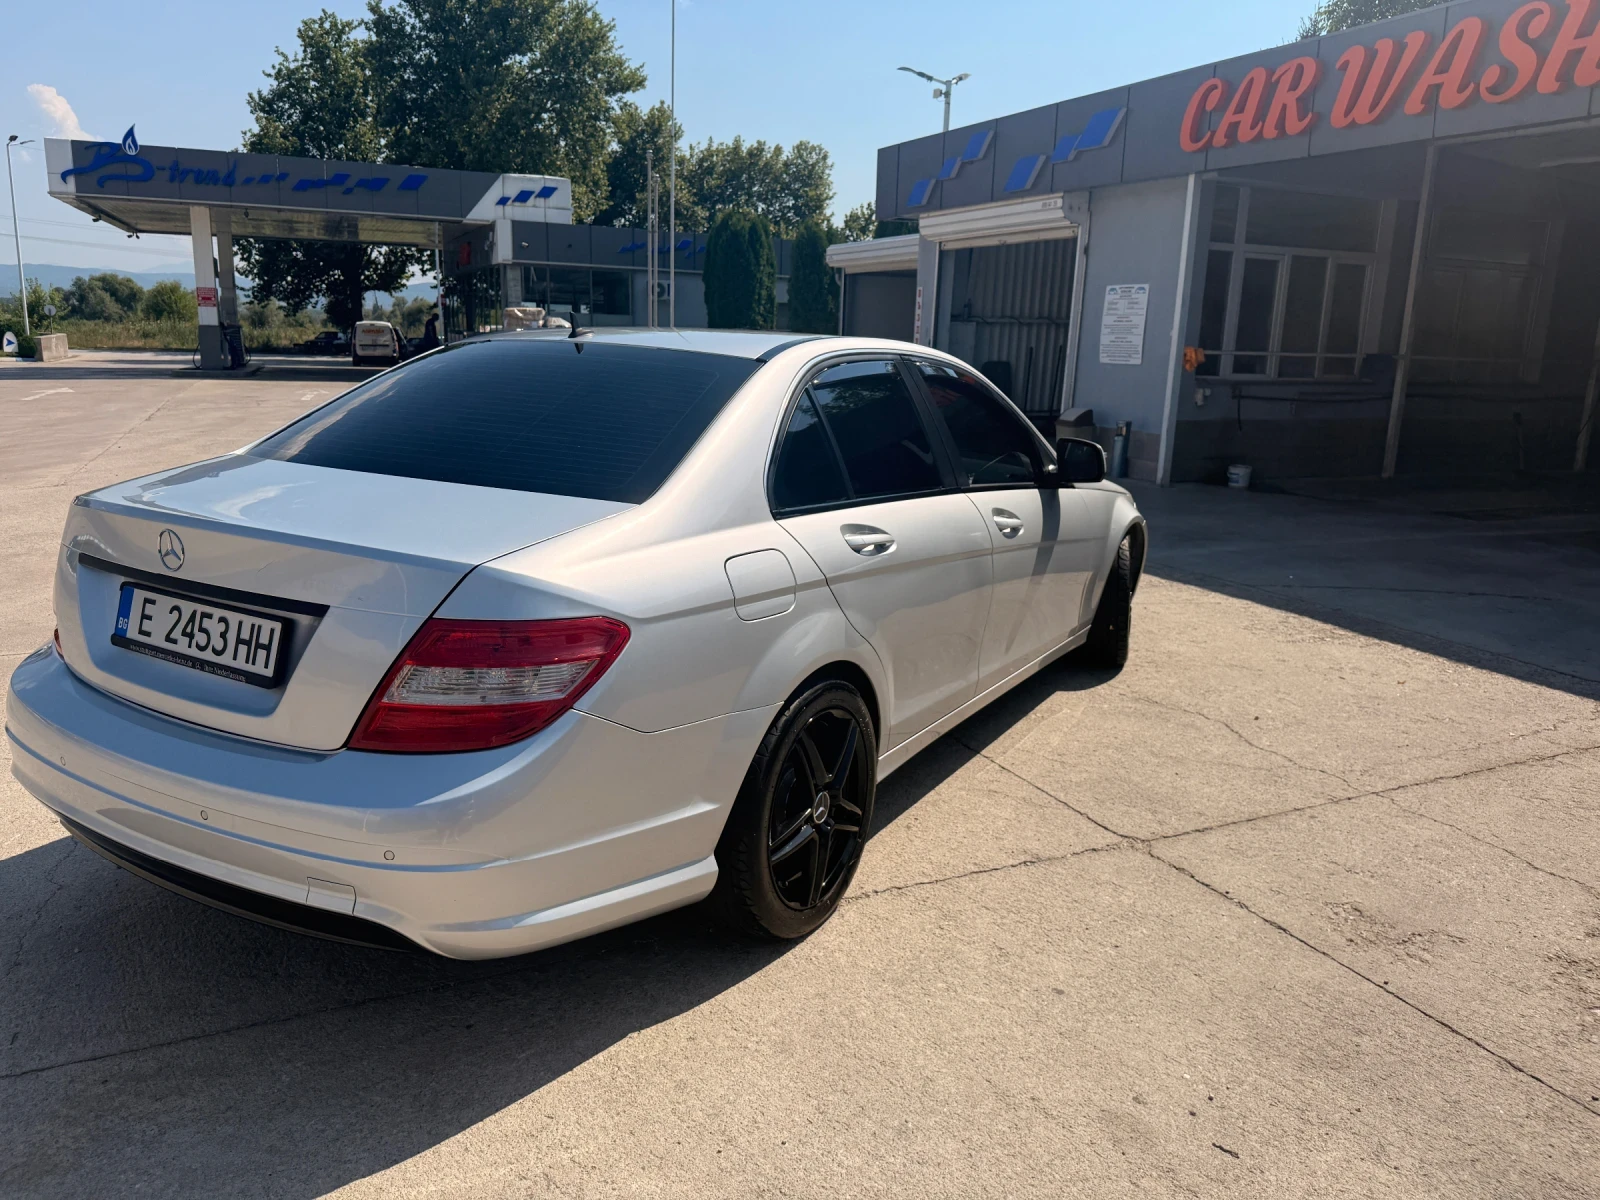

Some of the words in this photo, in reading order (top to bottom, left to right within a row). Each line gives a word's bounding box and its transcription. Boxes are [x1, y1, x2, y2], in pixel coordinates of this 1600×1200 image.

[1180, 56, 1322, 152] CAR
[1330, 0, 1600, 129] WASH
[118, 617, 128, 629] BG
[138, 597, 157, 637] E
[164, 604, 230, 656] 2453
